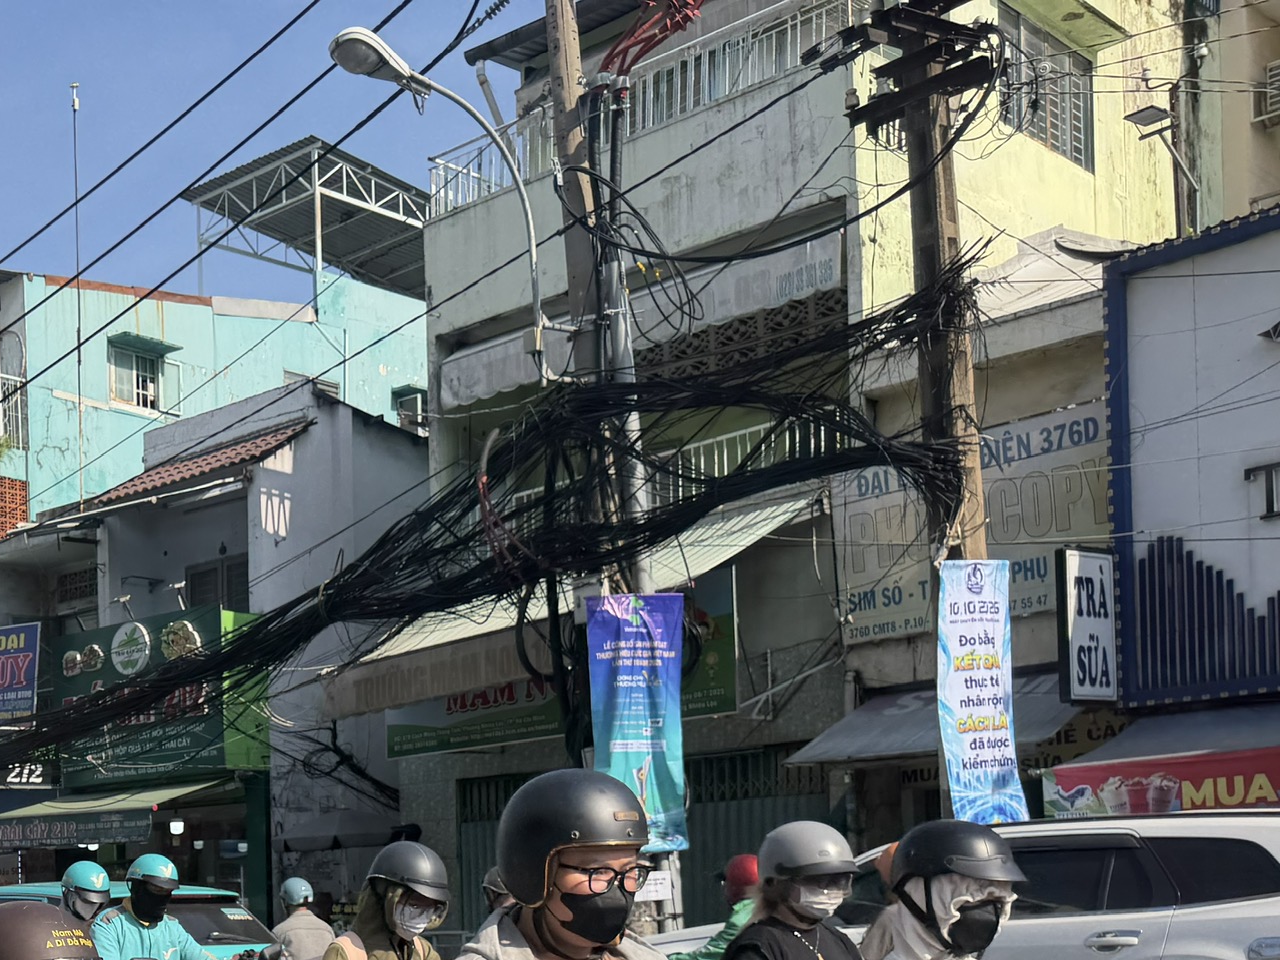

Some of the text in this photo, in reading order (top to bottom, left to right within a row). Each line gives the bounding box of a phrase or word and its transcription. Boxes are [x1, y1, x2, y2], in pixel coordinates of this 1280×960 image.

[1039, 416, 1099, 453] 376D
[849, 456, 1110, 574] PHOCOPY
[848, 588, 878, 613] SIM
[882, 577, 903, 608] SỐ
[1074, 564, 1109, 619] TRÀ
[849, 625, 870, 639] 376D
[959, 629, 995, 649] Đo bằg
[953, 649, 982, 672] KẾT
[1076, 632, 1111, 689] SỮA
[991, 710, 1009, 732] LÀ
[1181, 773, 1280, 809] MUA
[50, 821, 77, 838] 212
[46, 940, 54, 948] A
[51, 929, 73, 938] Nam
